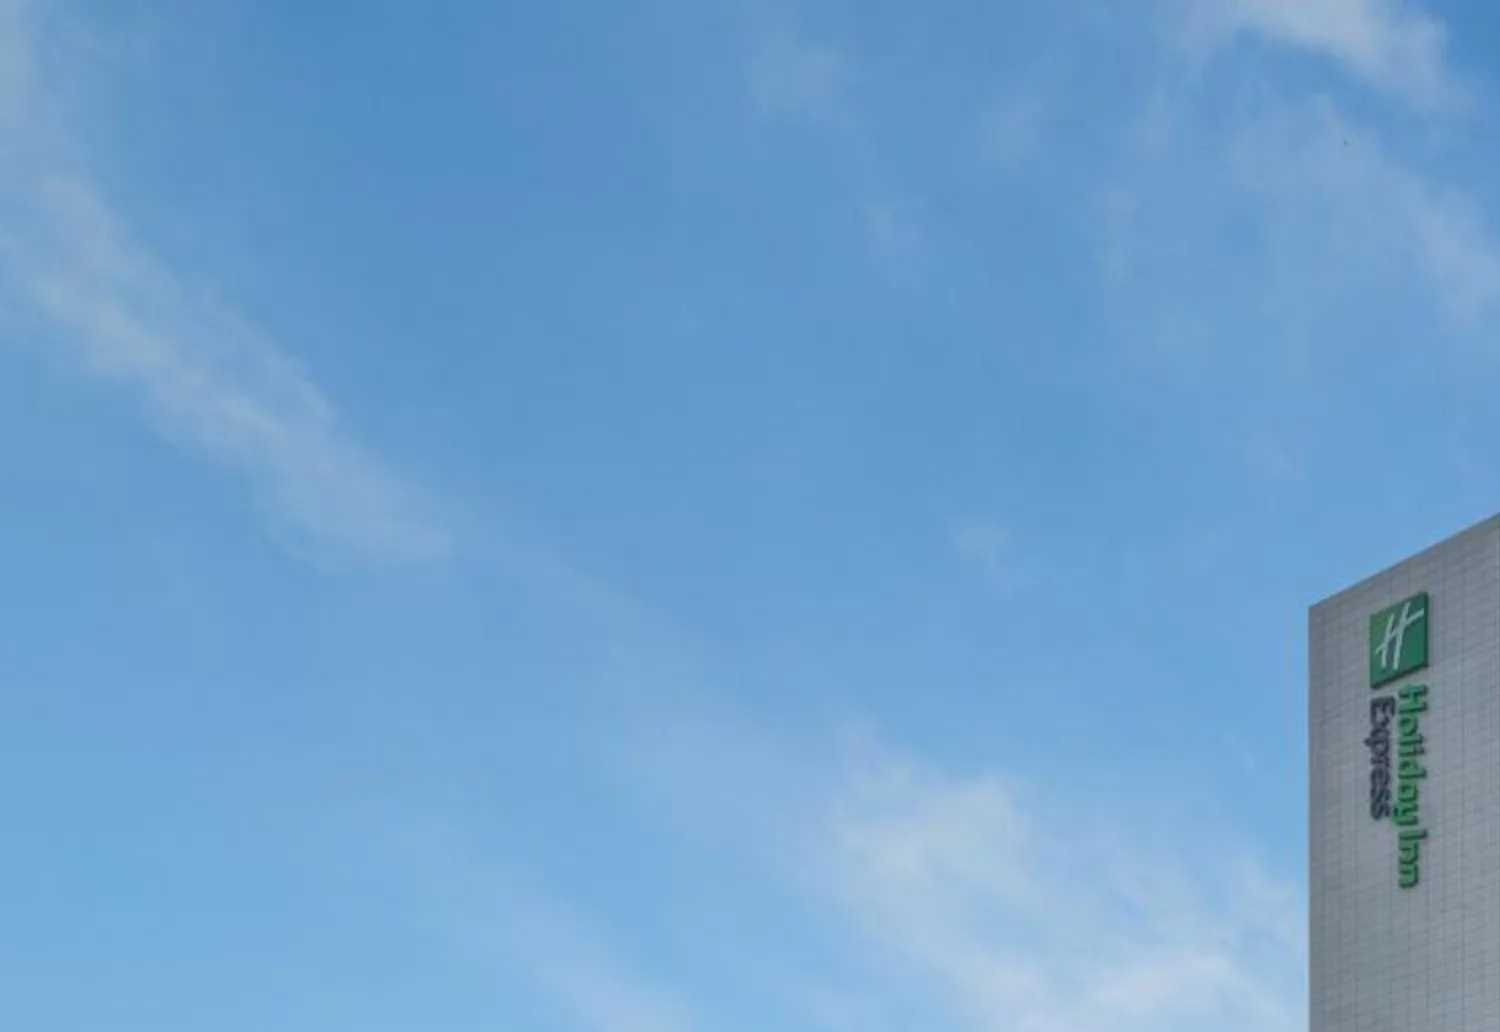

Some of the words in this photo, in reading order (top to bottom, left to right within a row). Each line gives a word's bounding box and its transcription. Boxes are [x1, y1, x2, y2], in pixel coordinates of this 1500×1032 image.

[1363, 697, 1396, 821] Express
[1391, 684, 1428, 825] Holiday
[1398, 829, 1428, 888] Inn
